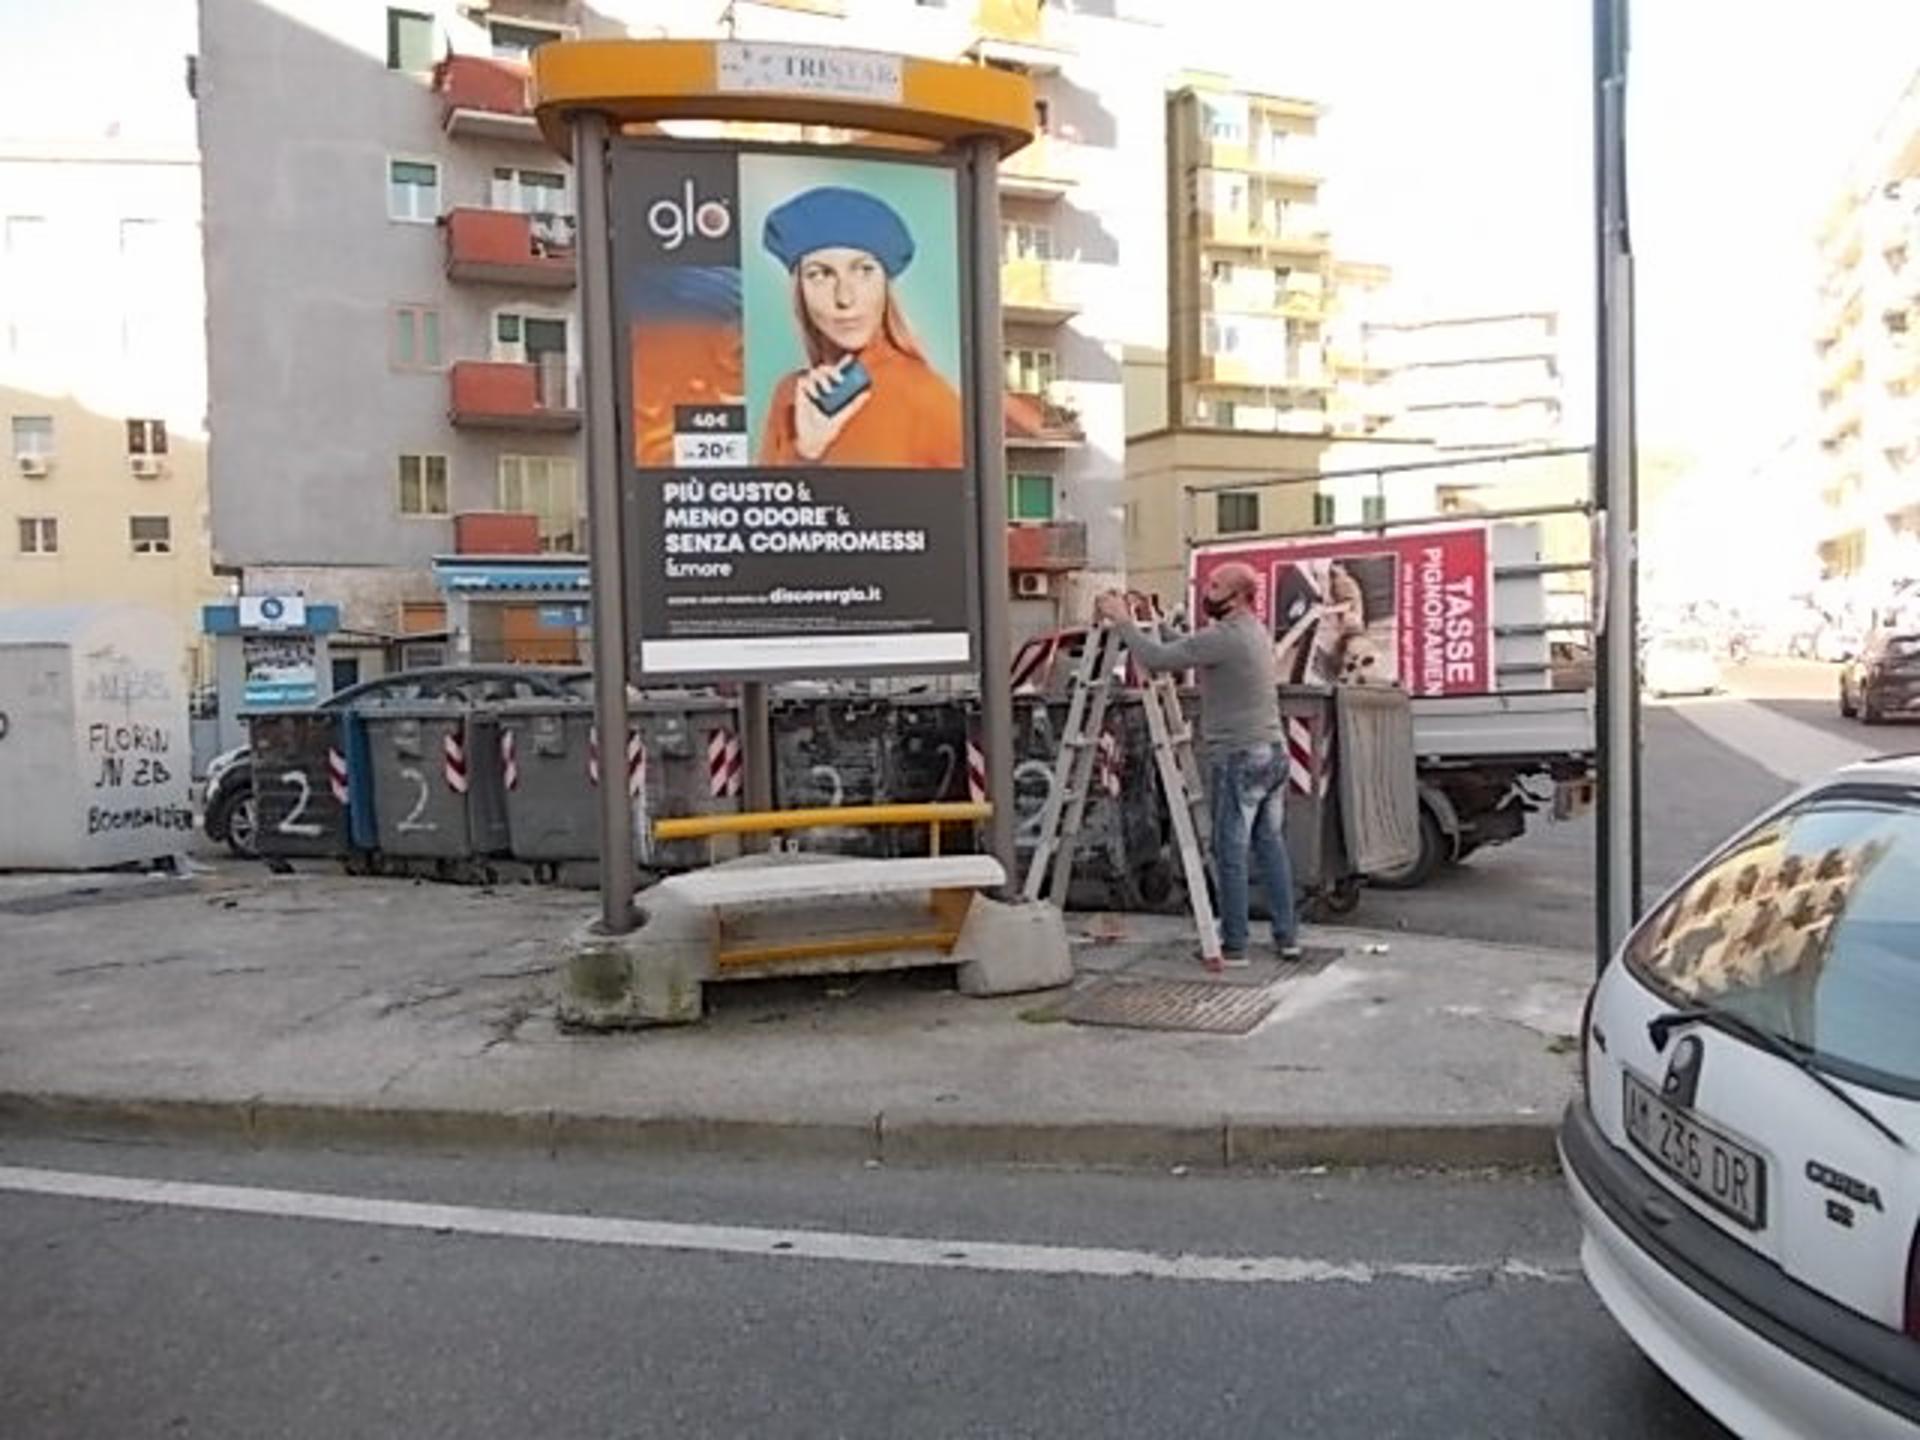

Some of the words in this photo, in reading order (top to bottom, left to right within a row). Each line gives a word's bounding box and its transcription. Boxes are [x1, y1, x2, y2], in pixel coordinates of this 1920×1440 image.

[648, 178, 731, 250] glo
[663, 477, 704, 502] PIÙ
[709, 482, 795, 502] GUSTO
[664, 507, 739, 528] MENO
[665, 532, 745, 554] SENZA
[749, 530, 926, 552] COMPROMESSI
[769, 585, 883, 606] discoverglo.it
[1445, 574, 1475, 683] TASSE
[278, 769, 323, 837] 2
[397, 766, 439, 832] 2
[1660, 1110, 1701, 1181] 236
[1712, 1144, 1750, 1211] DR
